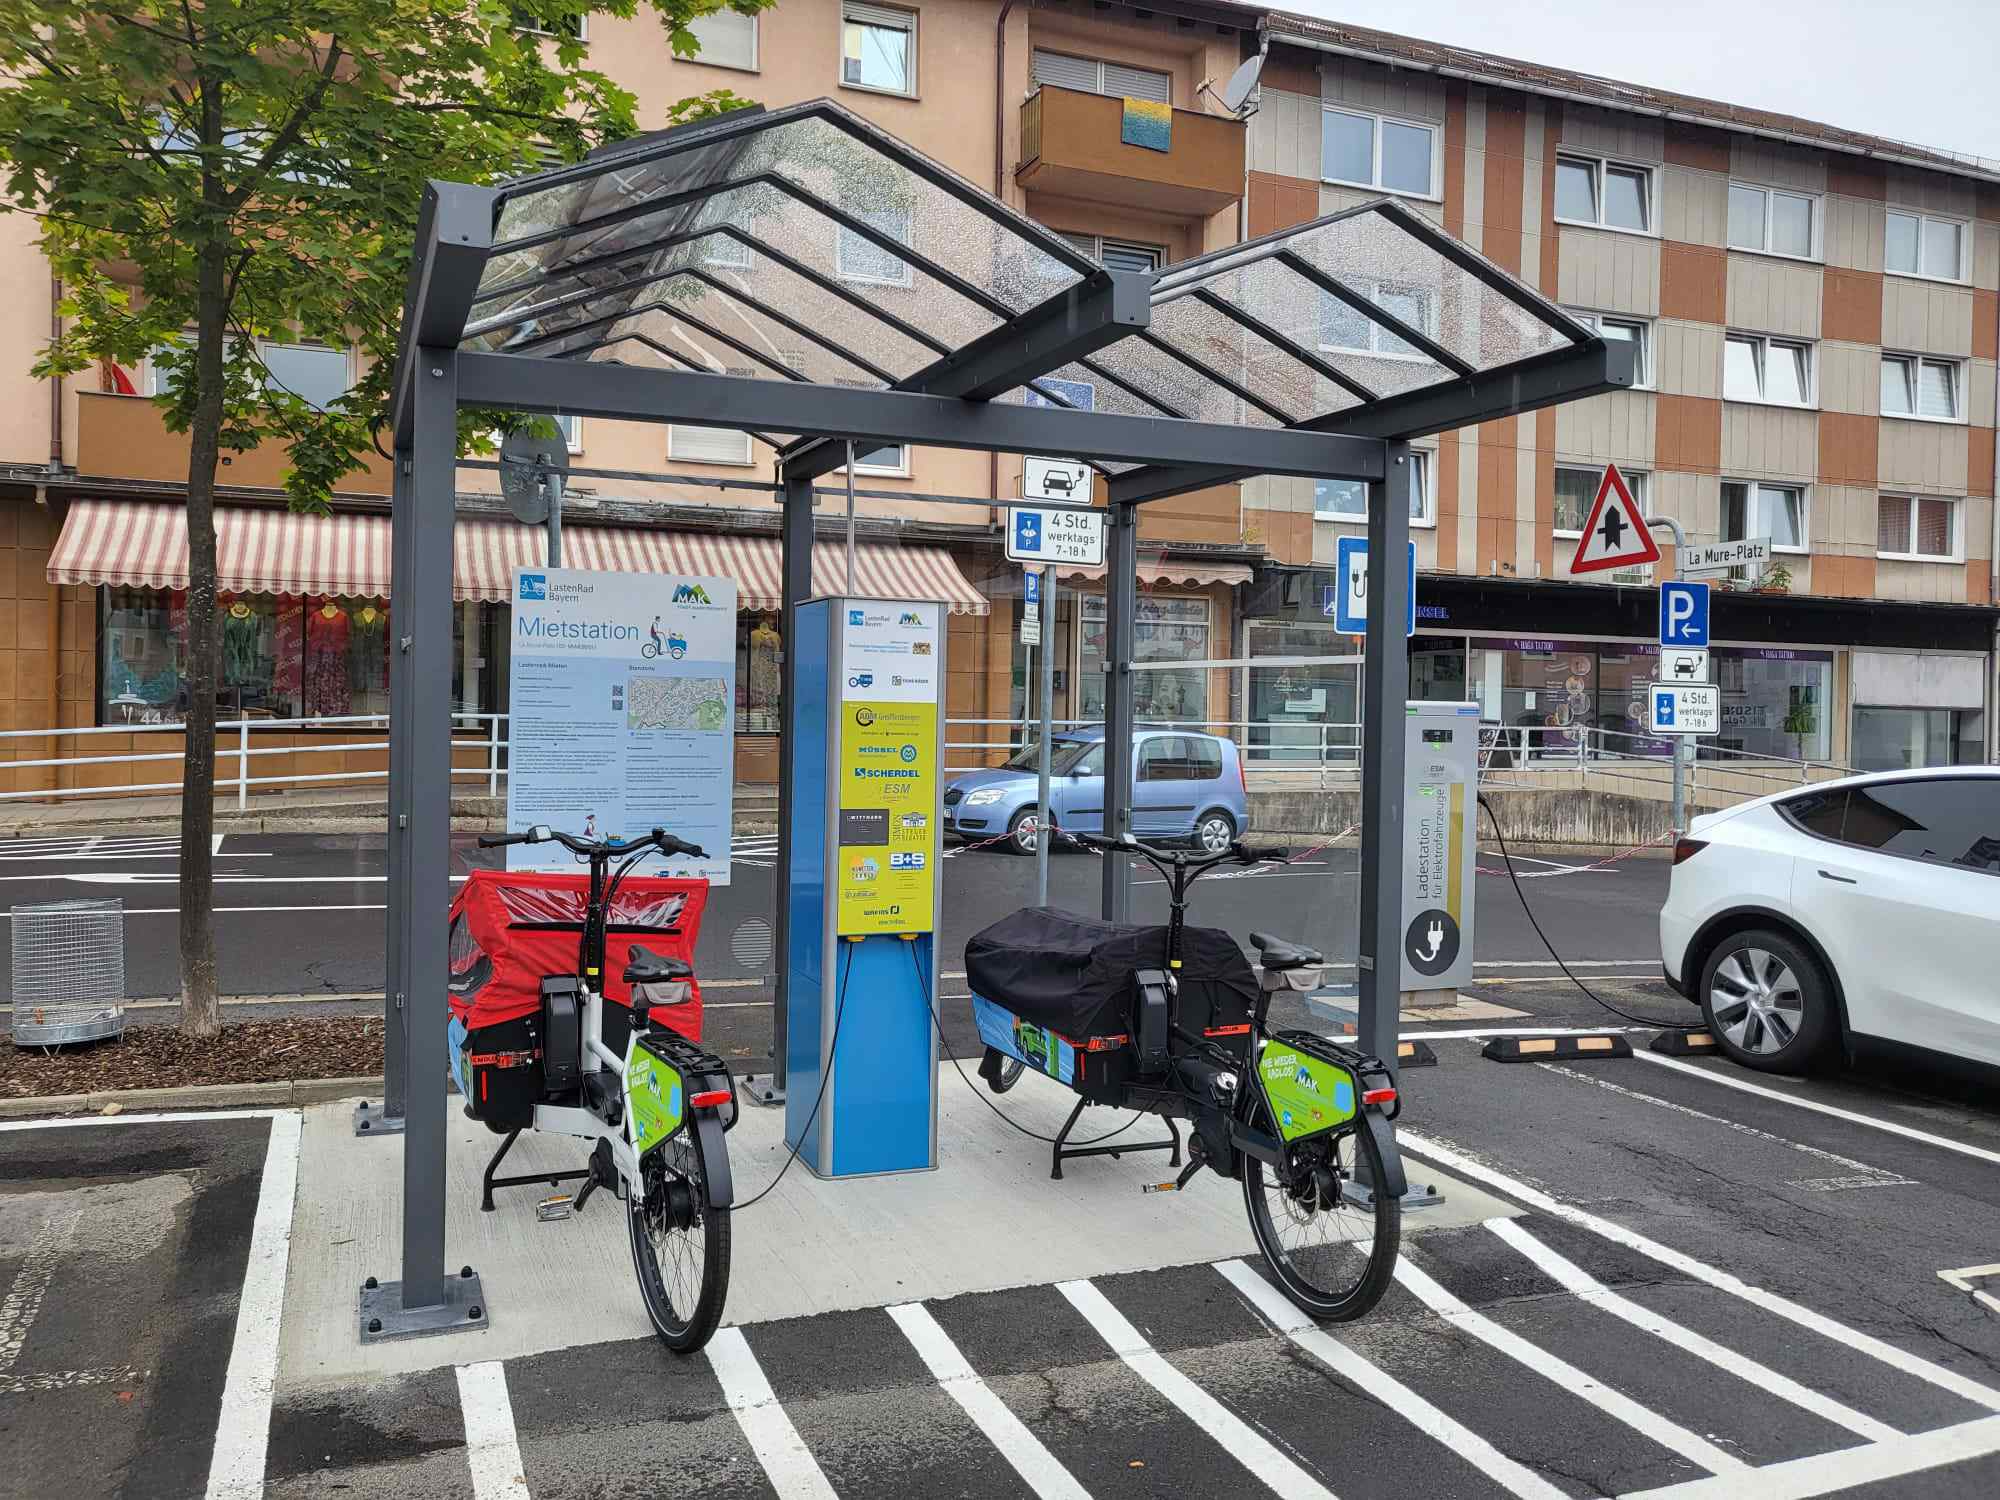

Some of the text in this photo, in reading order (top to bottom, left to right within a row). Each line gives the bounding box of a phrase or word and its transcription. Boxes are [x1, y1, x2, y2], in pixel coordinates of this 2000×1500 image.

[1051, 513, 1091, 530] 4 Std.
[1047, 532, 1096, 545] werktags
[1056, 545, 1087, 557] 7-18 h
[1689, 544, 1763, 565] La Mure-Platz
[549, 583, 594, 593] LastenRad
[549, 592, 579, 603] Bayern
[677, 593, 706, 604] MAK
[1668, 590, 1695, 638] P
[518, 615, 639, 641] Mietstation
[1681, 691, 1710, 704] 4 Std.
[1679, 708, 1713, 718] werktags
[866, 768, 920, 778] SCHERDEL
[883, 783, 912, 794] ESM
[1432, 788, 1446, 898] für Elektrofahrzeuge
[890, 853, 925, 865] B+S
[1415, 818, 1431, 899] Ladestation
[1297, 1074, 1318, 1091] MAK
